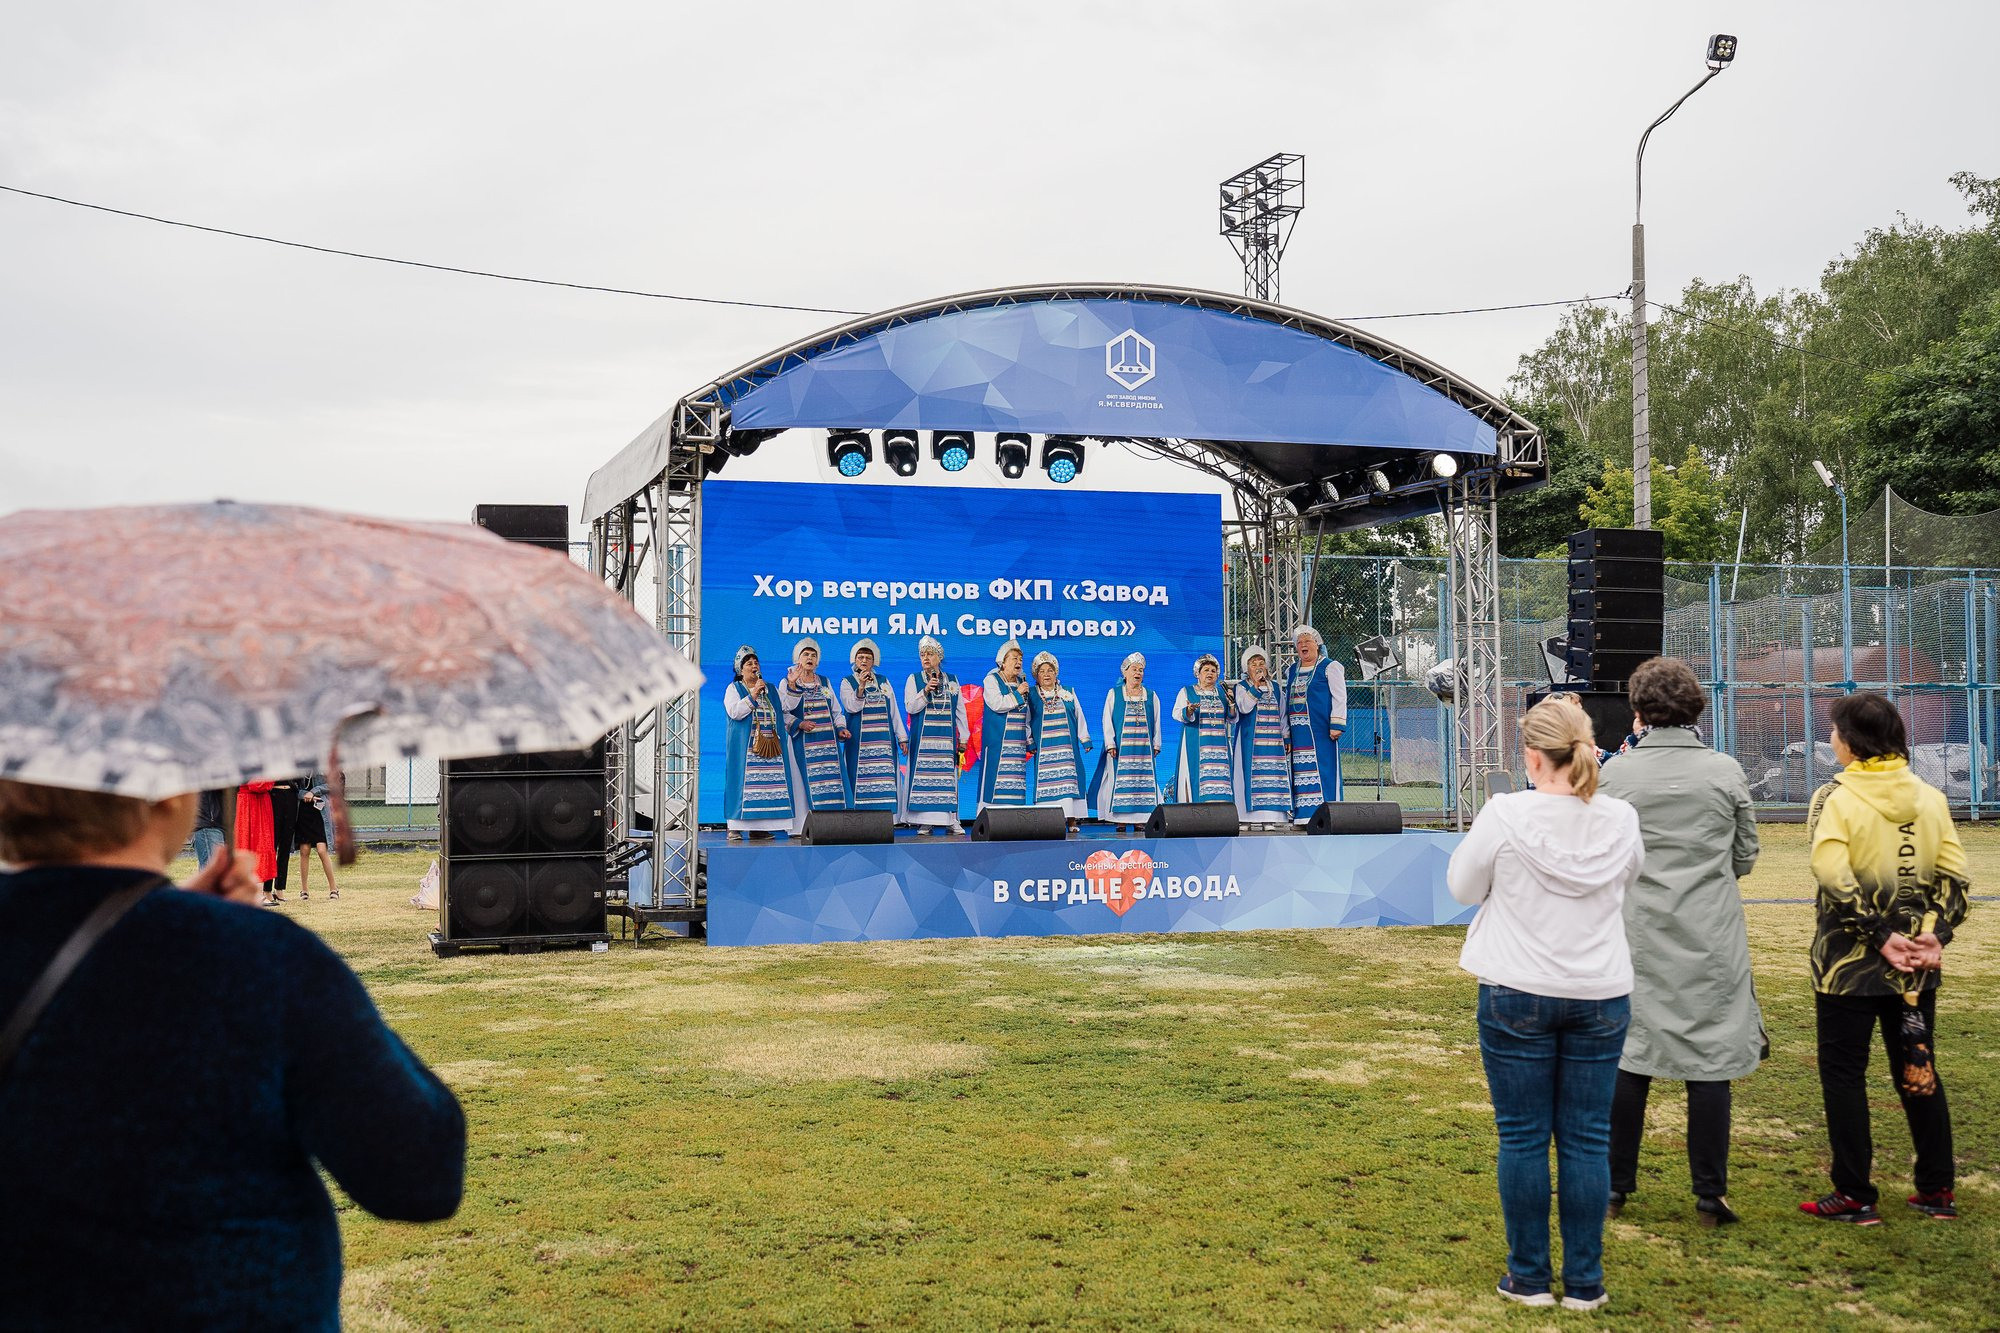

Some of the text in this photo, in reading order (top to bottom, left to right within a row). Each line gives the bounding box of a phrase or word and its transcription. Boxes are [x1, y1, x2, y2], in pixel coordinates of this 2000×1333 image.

[1098, 400, 1164, 410] Я.М.СВЕРДЛОВА
[752, 575, 1169, 606] Хор ветеранов ФКП «Завод
[781, 613, 1136, 640] имени Я.М. Свердлова»
[1068, 860, 1169, 873] Семейный фестиваль
[993, 874, 1242, 905] В СЕРДЦЕ ЗАВОДА
